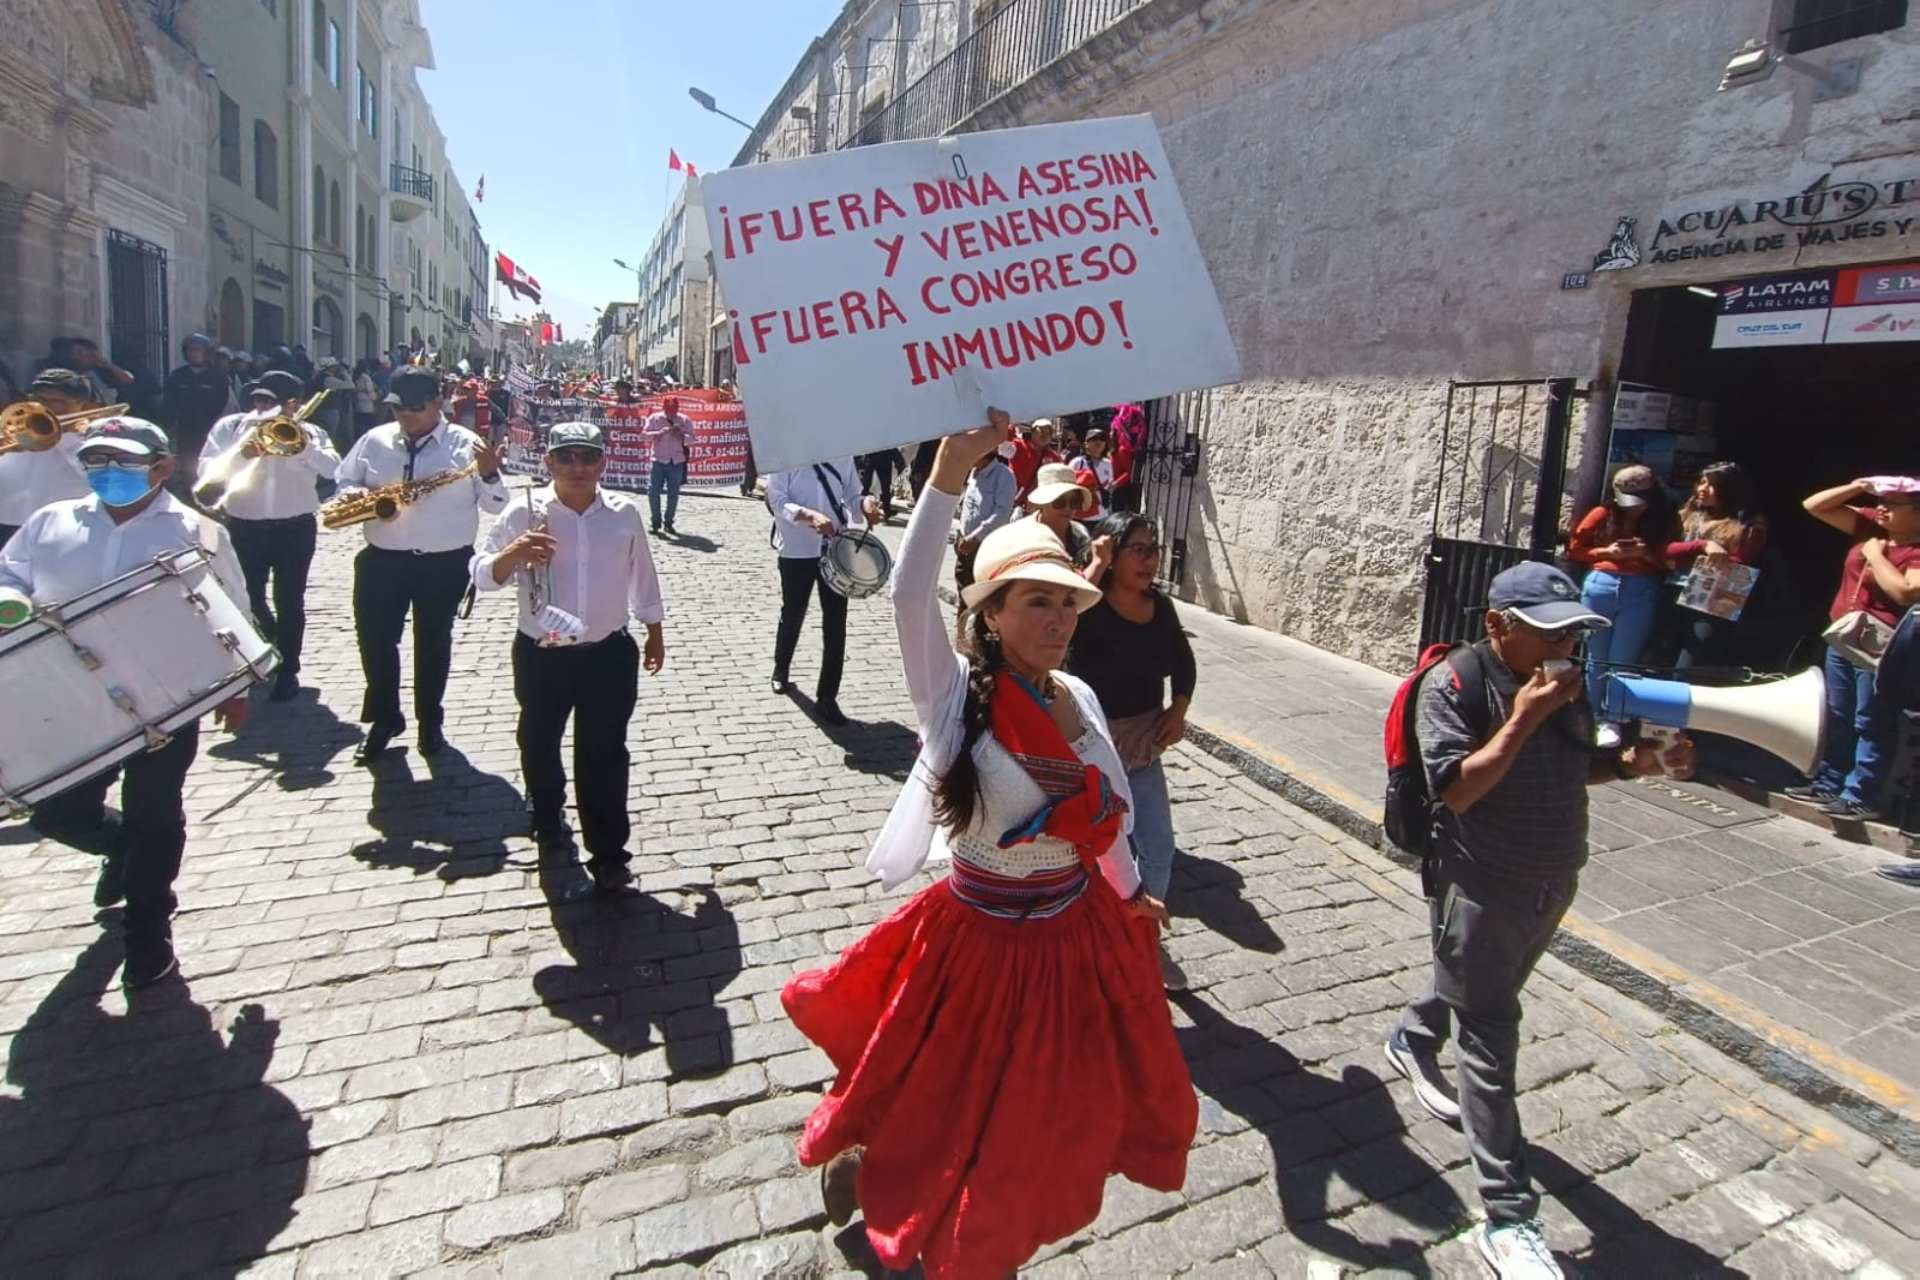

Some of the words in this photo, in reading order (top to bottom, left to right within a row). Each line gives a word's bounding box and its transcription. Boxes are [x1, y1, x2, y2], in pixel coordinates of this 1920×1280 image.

[718, 187, 905, 259] ¡FUERA
[913, 171, 1008, 215] DINA
[1018, 149, 1157, 201] ASESINA
[873, 234, 905, 277] Y
[921, 187, 1160, 262] VENENOSA!
[1650, 239, 1747, 264] AGENCIA
[1754, 234, 1786, 253] DE
[1894, 217, 1914, 236] Y
[728, 287, 907, 365] ¡FUERA
[920, 243, 1137, 315] CONGRESO
[1746, 295, 1829, 308] AIRLINES
[1748, 279, 1830, 296] LATAM
[903, 300, 1133, 385] INMUNDO!
